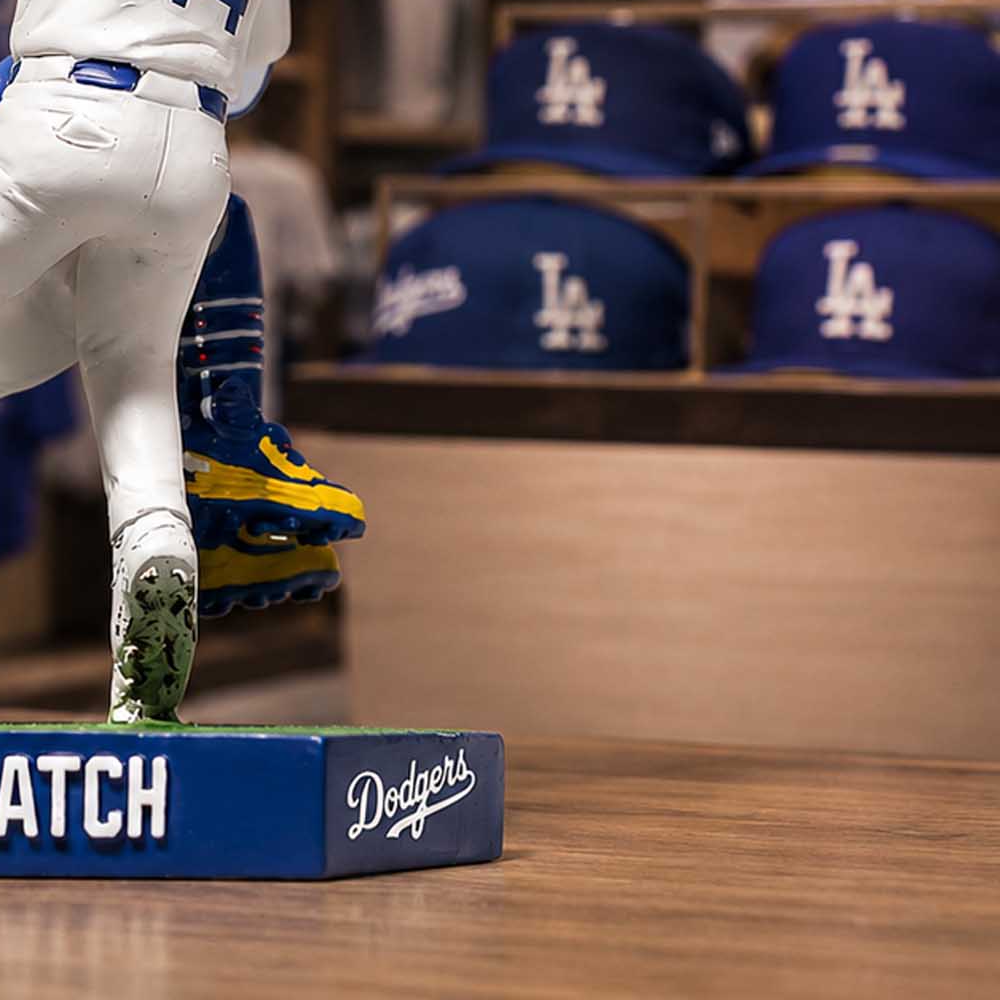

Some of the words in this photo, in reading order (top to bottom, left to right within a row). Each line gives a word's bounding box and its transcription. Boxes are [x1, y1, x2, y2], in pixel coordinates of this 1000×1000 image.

[536, 36, 605, 126] LA
[833, 38, 905, 130] LA
[533, 252, 606, 351] LA
[816, 240, 894, 340] LA
[347, 748, 477, 840] Dodgers
